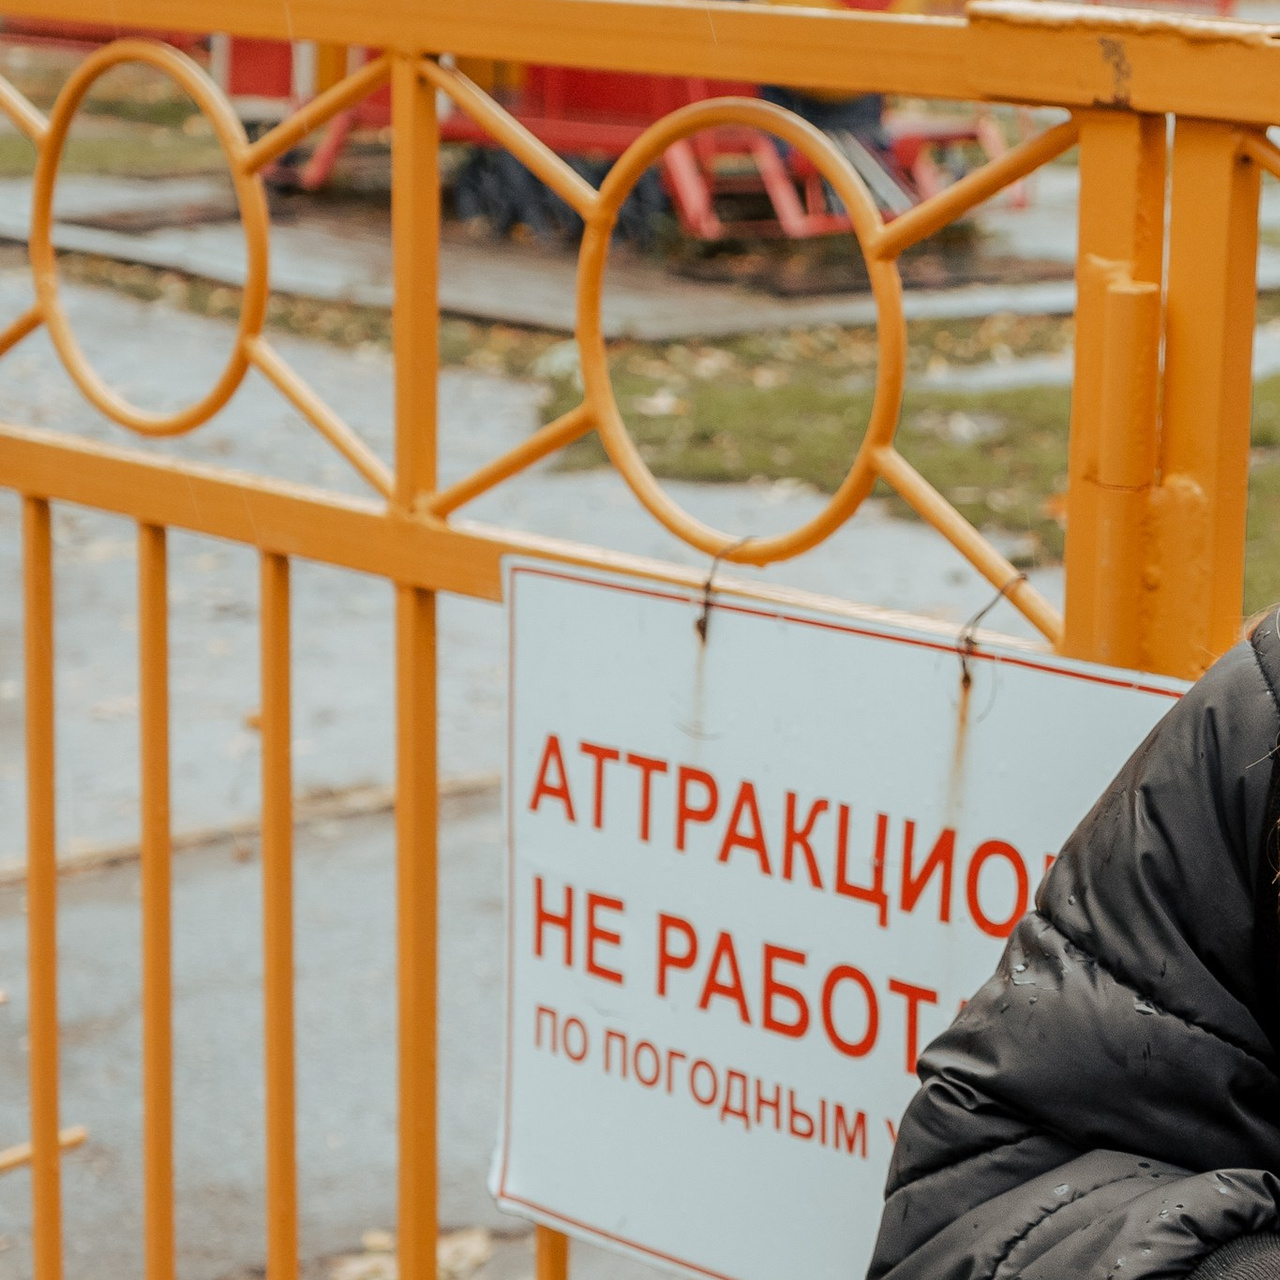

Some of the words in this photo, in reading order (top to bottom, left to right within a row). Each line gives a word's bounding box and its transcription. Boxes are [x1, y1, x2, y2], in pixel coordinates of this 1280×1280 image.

[529, 733, 1057, 940] АТТРАКЦИО
[534, 876, 625, 985] НЕ
[656, 912, 968, 1076] РАБОТ
[534, 1003, 589, 1065] ПО
[604, 1028, 868, 1158] ПОГОДНЫМ
